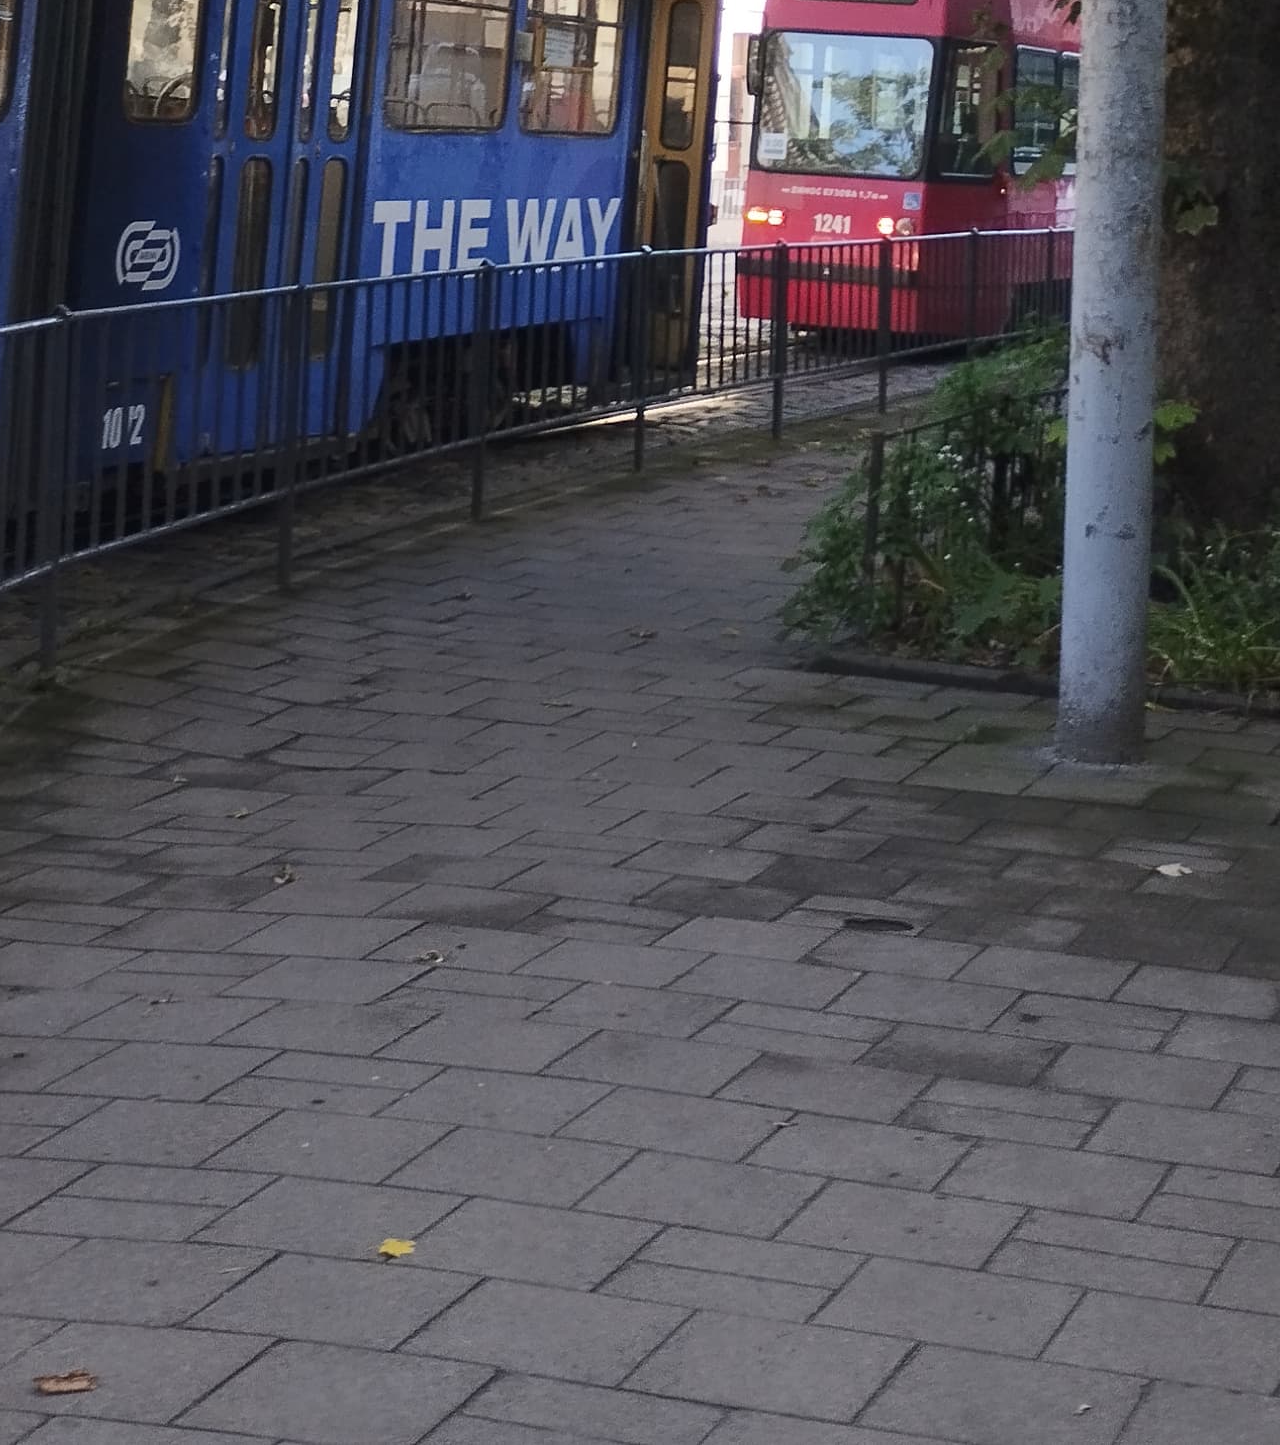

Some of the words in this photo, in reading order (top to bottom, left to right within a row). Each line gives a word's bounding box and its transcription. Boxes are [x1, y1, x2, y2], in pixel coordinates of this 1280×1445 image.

[373, 199, 491, 279] THE
[506, 197, 621, 272] WAY
[813, 213, 852, 235] 1241
[101, 404, 146, 450] 102
